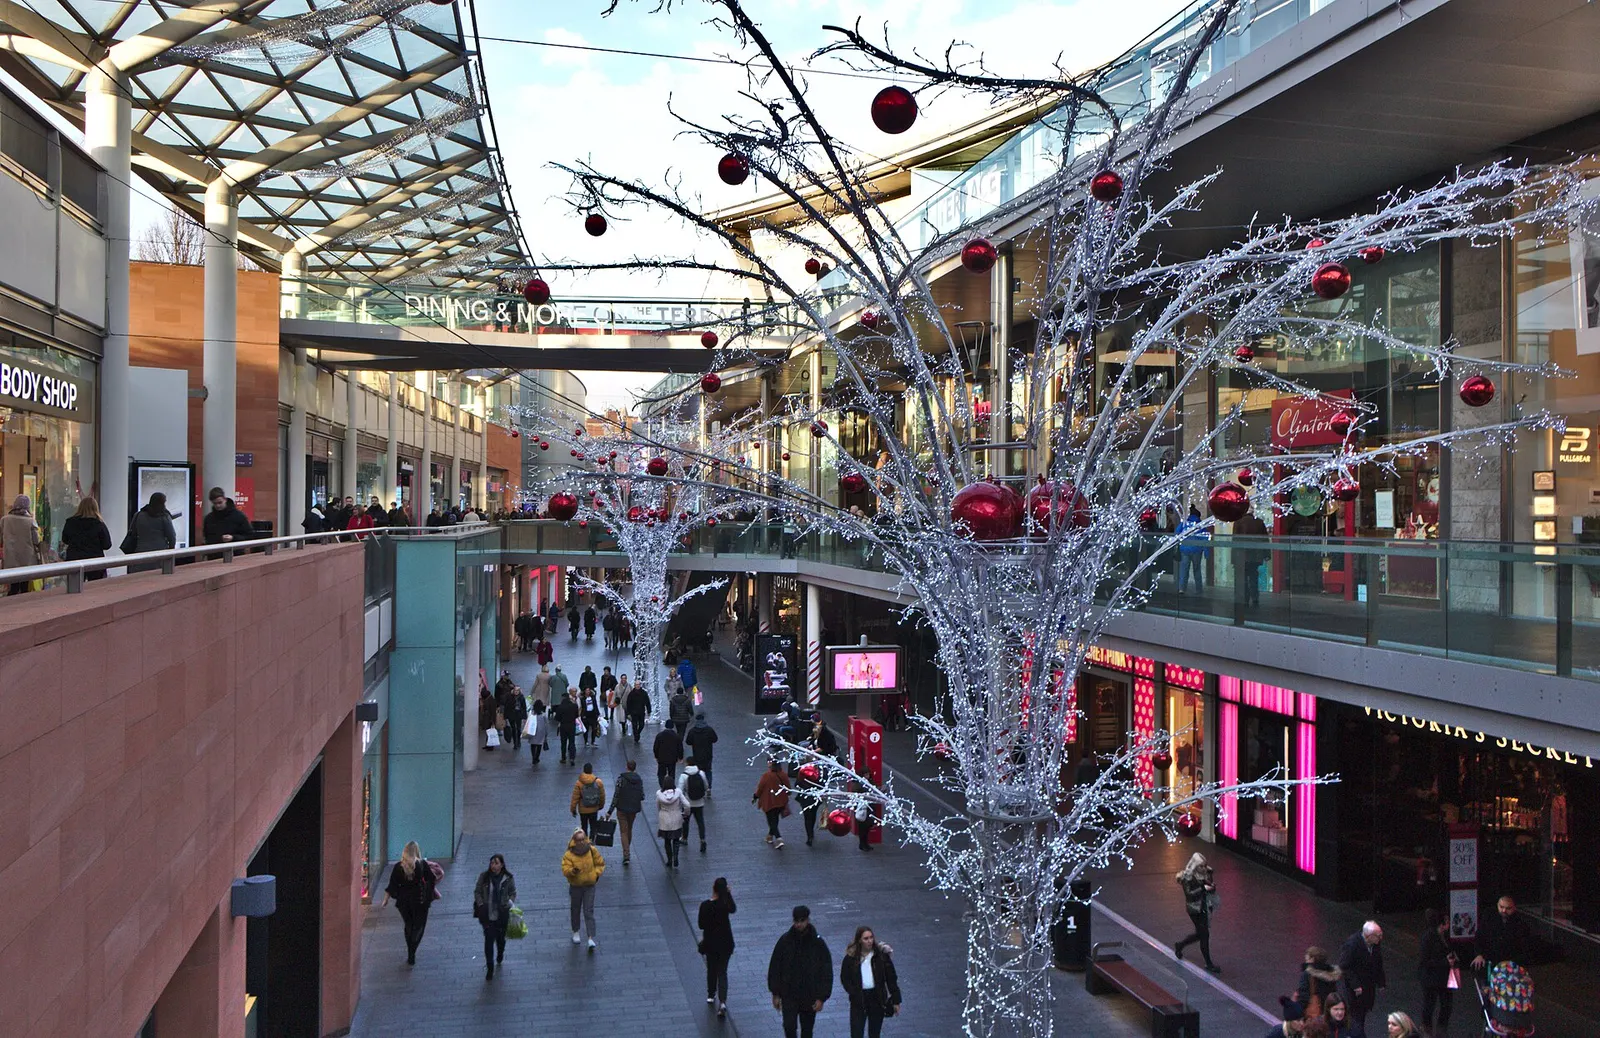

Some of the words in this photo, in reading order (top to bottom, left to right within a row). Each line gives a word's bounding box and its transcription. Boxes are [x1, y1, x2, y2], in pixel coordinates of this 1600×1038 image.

[405, 295, 488, 321] DINING
[496, 302, 511, 322] &
[517, 303, 586, 327] MORE
[633, 306, 652, 316] THE
[0, 362, 41, 402] BODY
[527, 371, 539, 489] DEBNHAMS
[1365, 706, 1485, 742] VICTORIAS
[1453, 855, 1475, 865] OFF
[1067, 915, 1077, 929] 1
